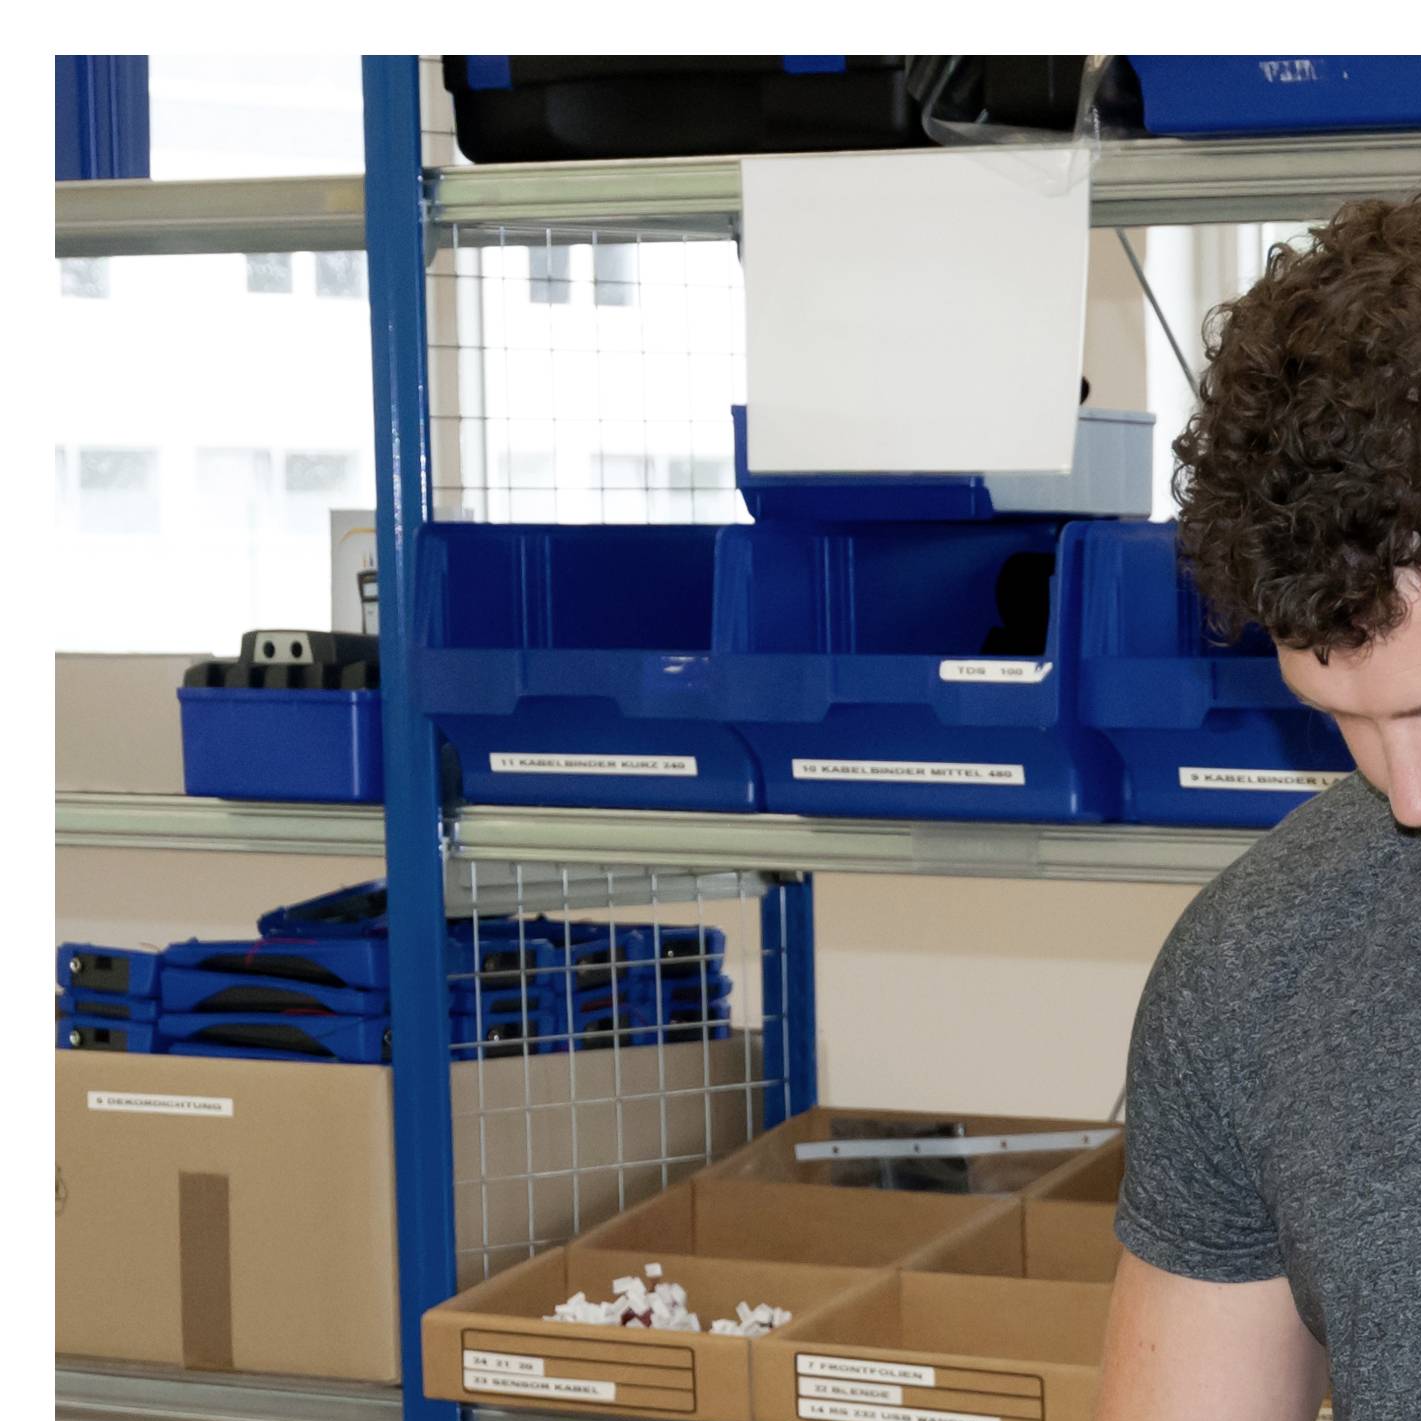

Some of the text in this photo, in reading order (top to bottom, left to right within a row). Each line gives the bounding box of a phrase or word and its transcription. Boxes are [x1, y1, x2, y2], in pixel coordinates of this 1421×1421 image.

[518, 758, 617, 769] KABELBINDER
[620, 760, 659, 770] KURZ
[821, 765, 926, 776] KABELBINDER
[930, 767, 982, 778] MITTEL
[1203, 773, 1318, 786] KABELBINDER
[819, 1362, 923, 1380] FRONTFOLIEN
[553, 1383, 599, 1395] KABEL
[831, 1385, 891, 1400] BLENDE
